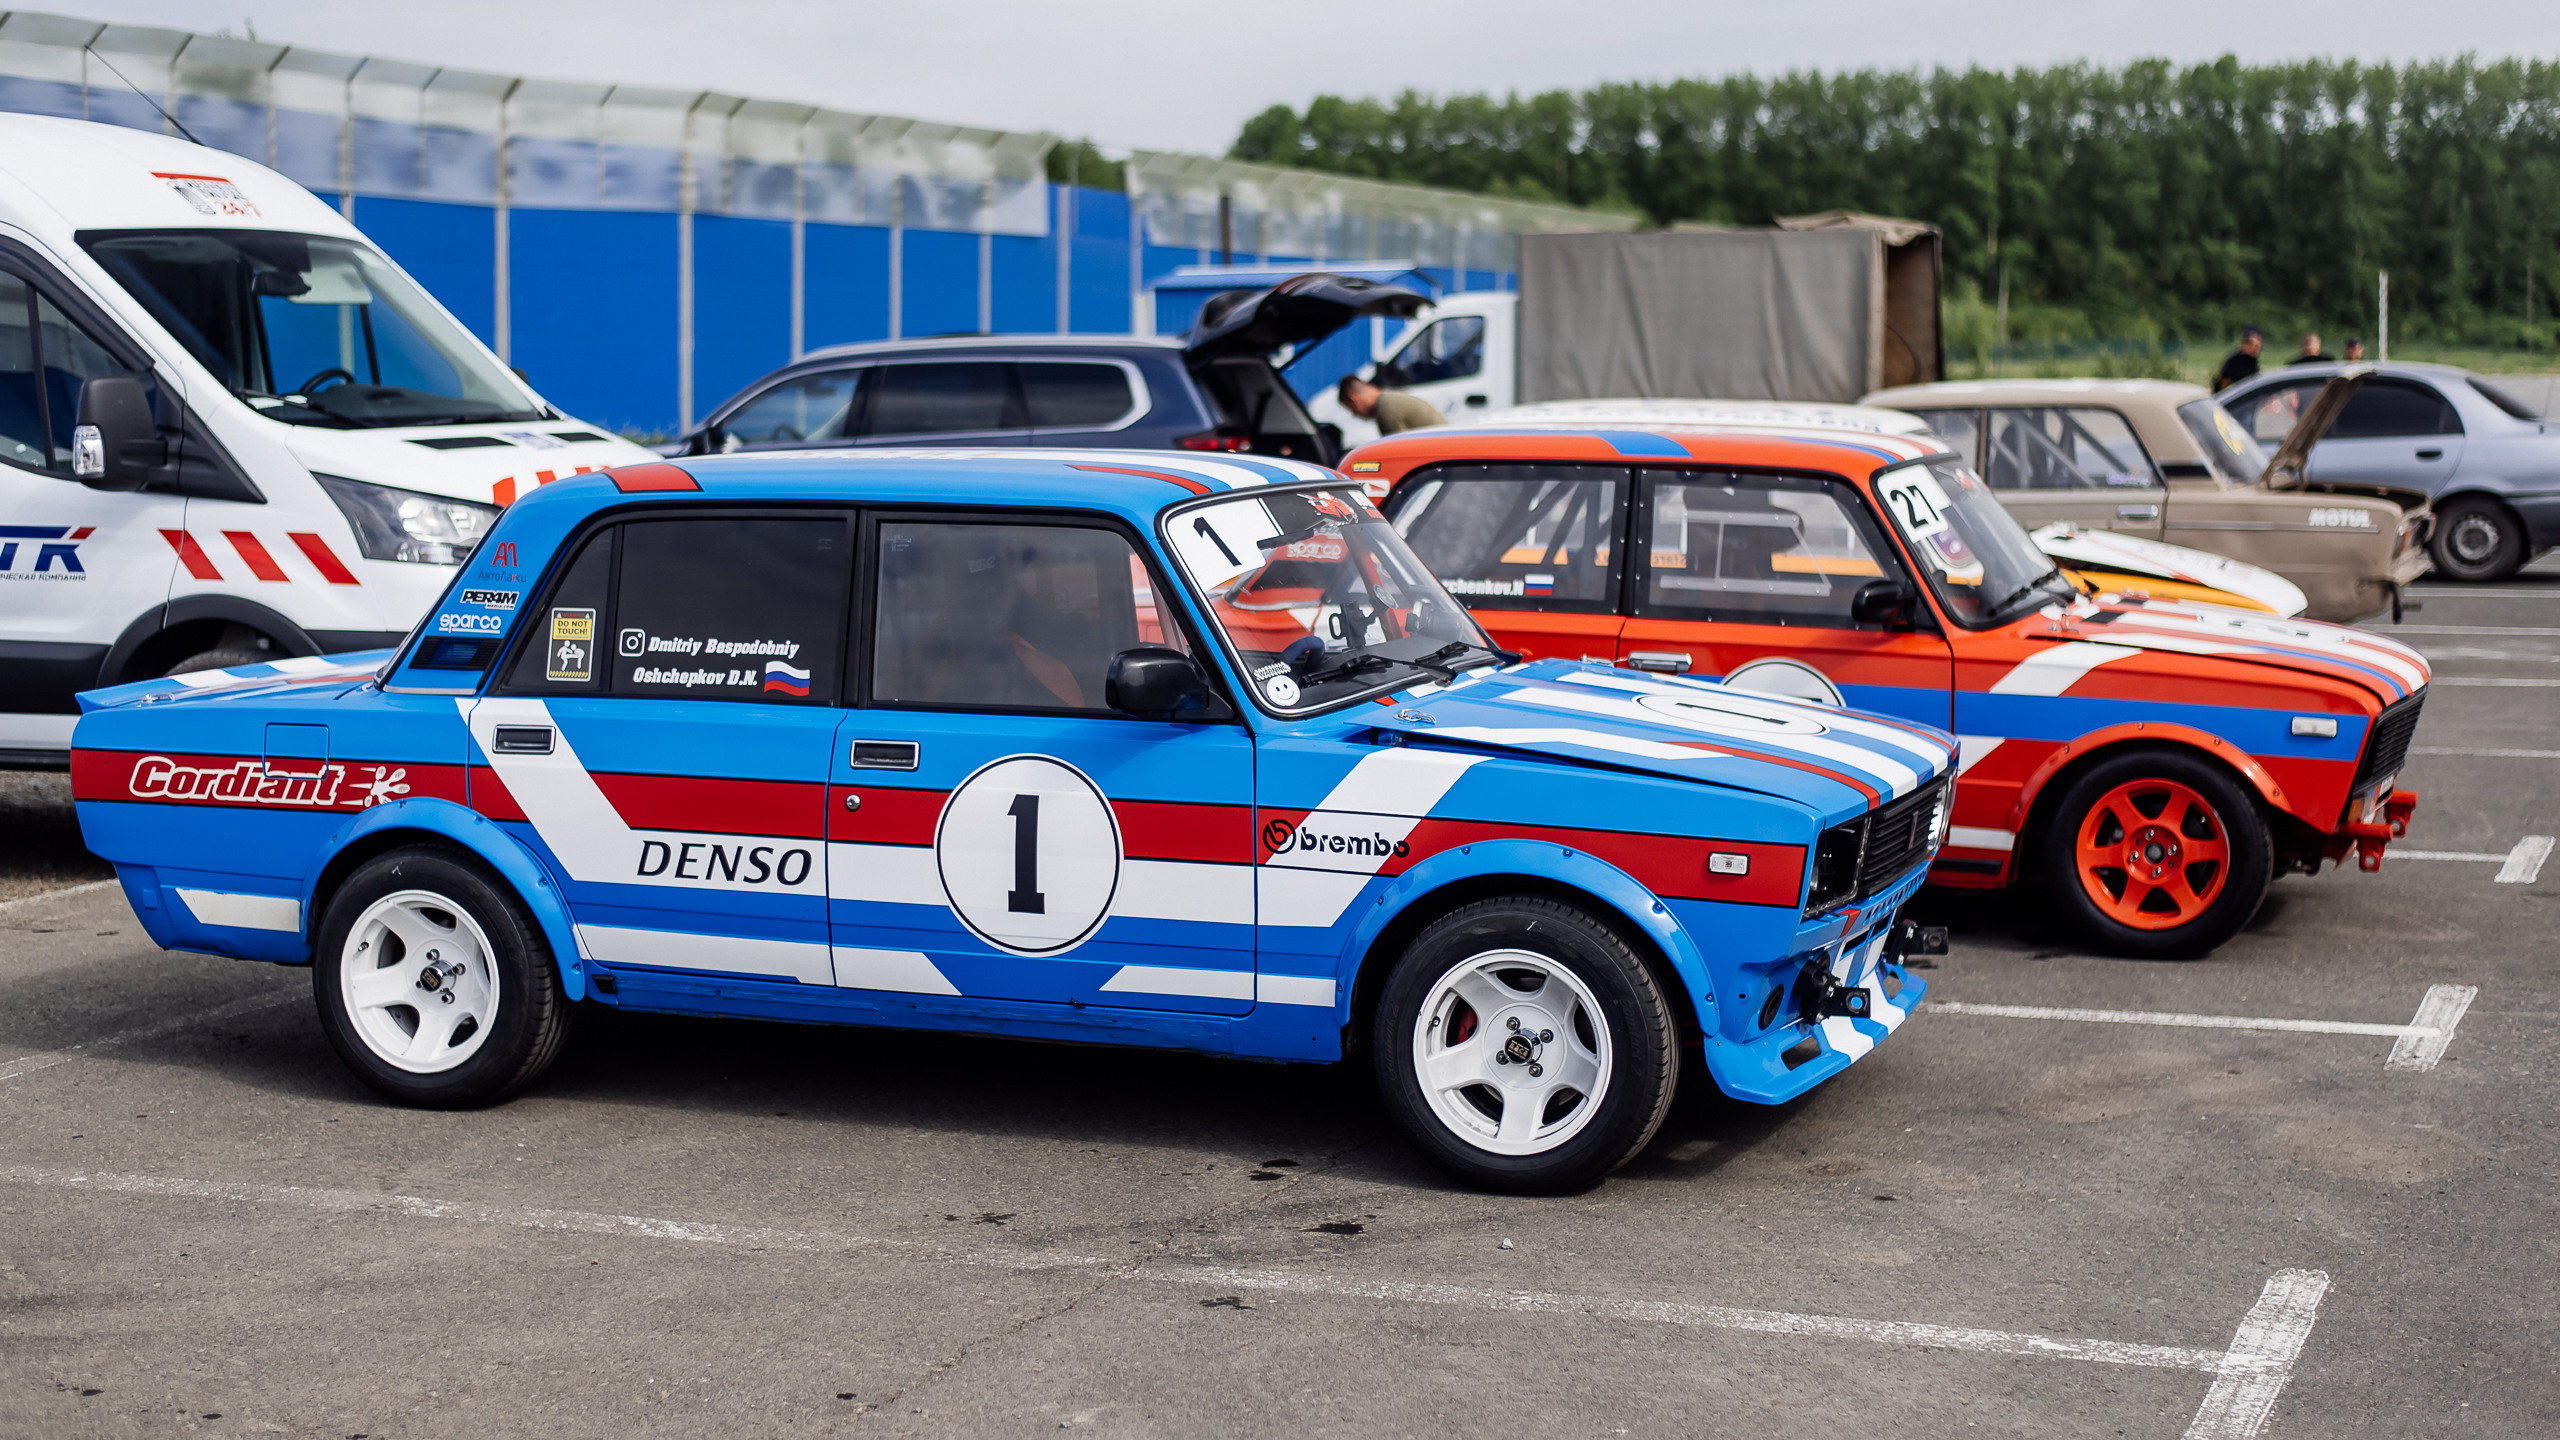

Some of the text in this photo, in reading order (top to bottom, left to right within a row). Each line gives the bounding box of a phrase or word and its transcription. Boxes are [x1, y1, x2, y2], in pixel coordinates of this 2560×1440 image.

[2308, 507, 2371, 528] MOTUL
[1193, 516, 1243, 568] 1
[439, 613, 502, 633] sparco
[571, 620, 588, 628] NOT
[648, 636, 800, 659] Dmitriy Bespodobniy
[633, 667, 758, 688] Oshchepkov D.N.
[129, 756, 345, 805] Cordiant
[1007, 794, 1046, 915] 1
[1300, 827, 1411, 858] brembo
[637, 840, 813, 886] DENSO
